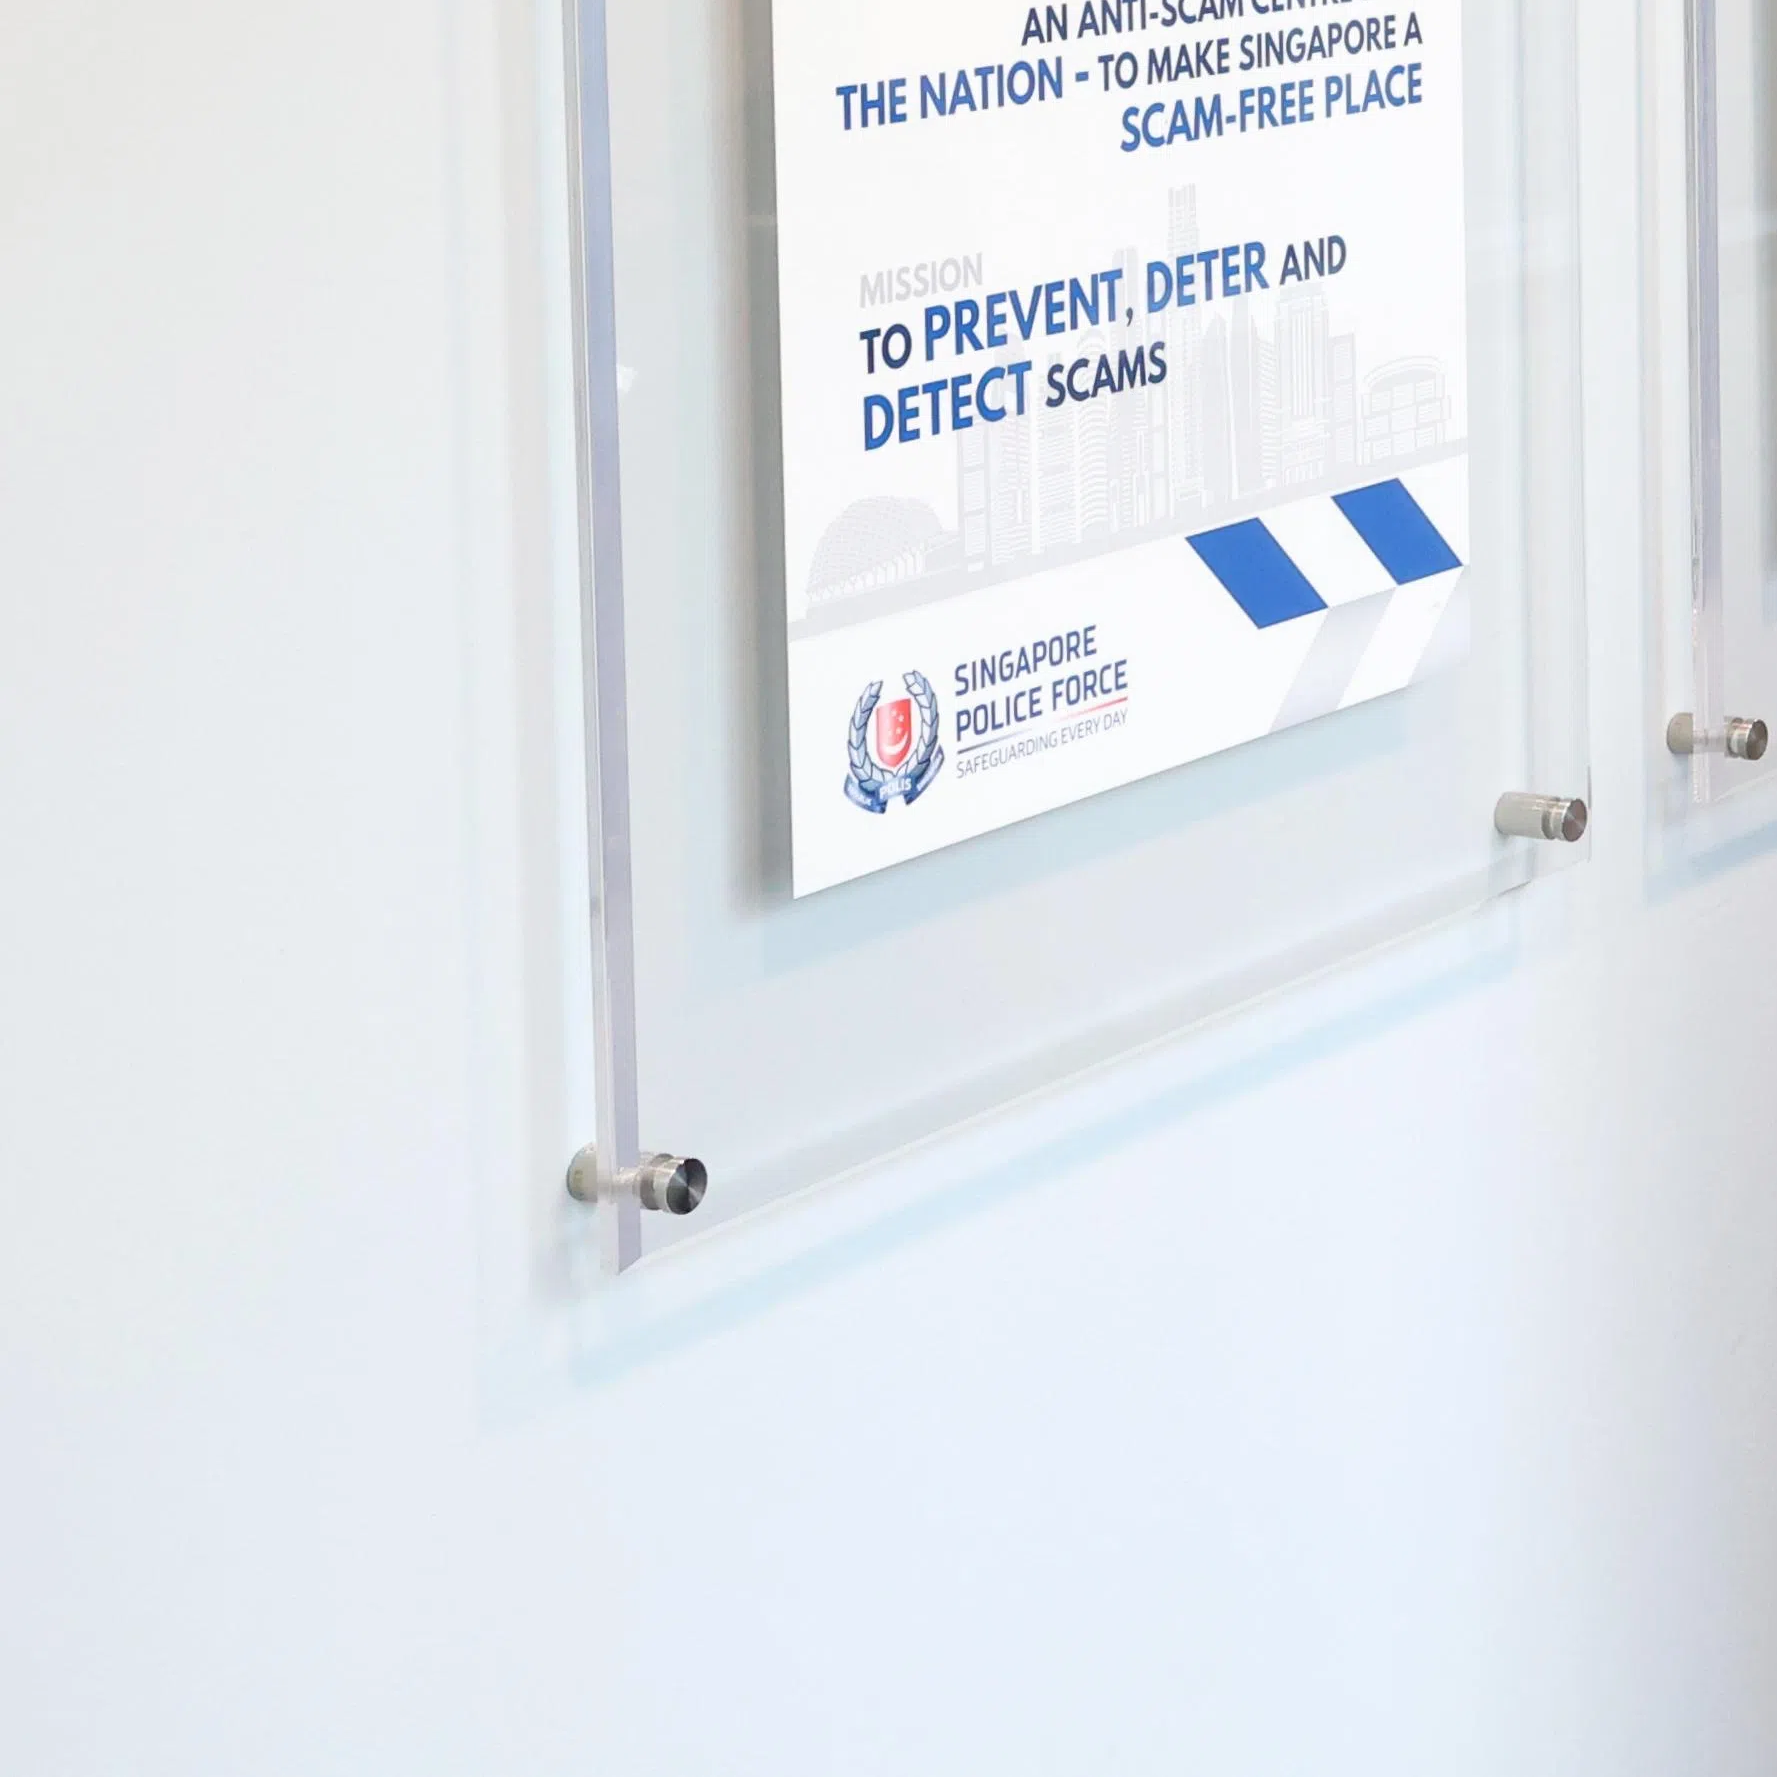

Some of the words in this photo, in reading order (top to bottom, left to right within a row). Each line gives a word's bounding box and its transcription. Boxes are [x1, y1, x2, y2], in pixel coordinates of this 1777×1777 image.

[1021, 2, 1068, 46] AN
[837, 78, 907, 130] THE
[919, 57, 1064, 120] NATION
[1100, 53, 1138, 93] TO
[1147, 38, 1230, 86] MAKE
[1239, 18, 1396, 73] SINGAPORE
[1403, 12, 1423, 46] A
[1121, 76, 1315, 151] SCAM-FREE
[1325, 63, 1423, 118] PLACE
[860, 254, 983, 308] MISSION
[860, 324, 912, 374] TO
[924, 269, 1134, 361] PREVENT,
[1147, 241, 1269, 314] DETER
[1279, 235, 1347, 285] AND
[864, 362, 1033, 451] DETECT
[1046, 341, 1168, 407] SCAMS
[954, 625, 1097, 697] SINGAPORE
[956, 696, 1043, 742] POLICE
[1052, 659, 1129, 716] FORCE
[956, 733, 1059, 779] SAFEGUARDING
[1061, 720, 1101, 749] EVERY
[1103, 707, 1129, 733] DAY
